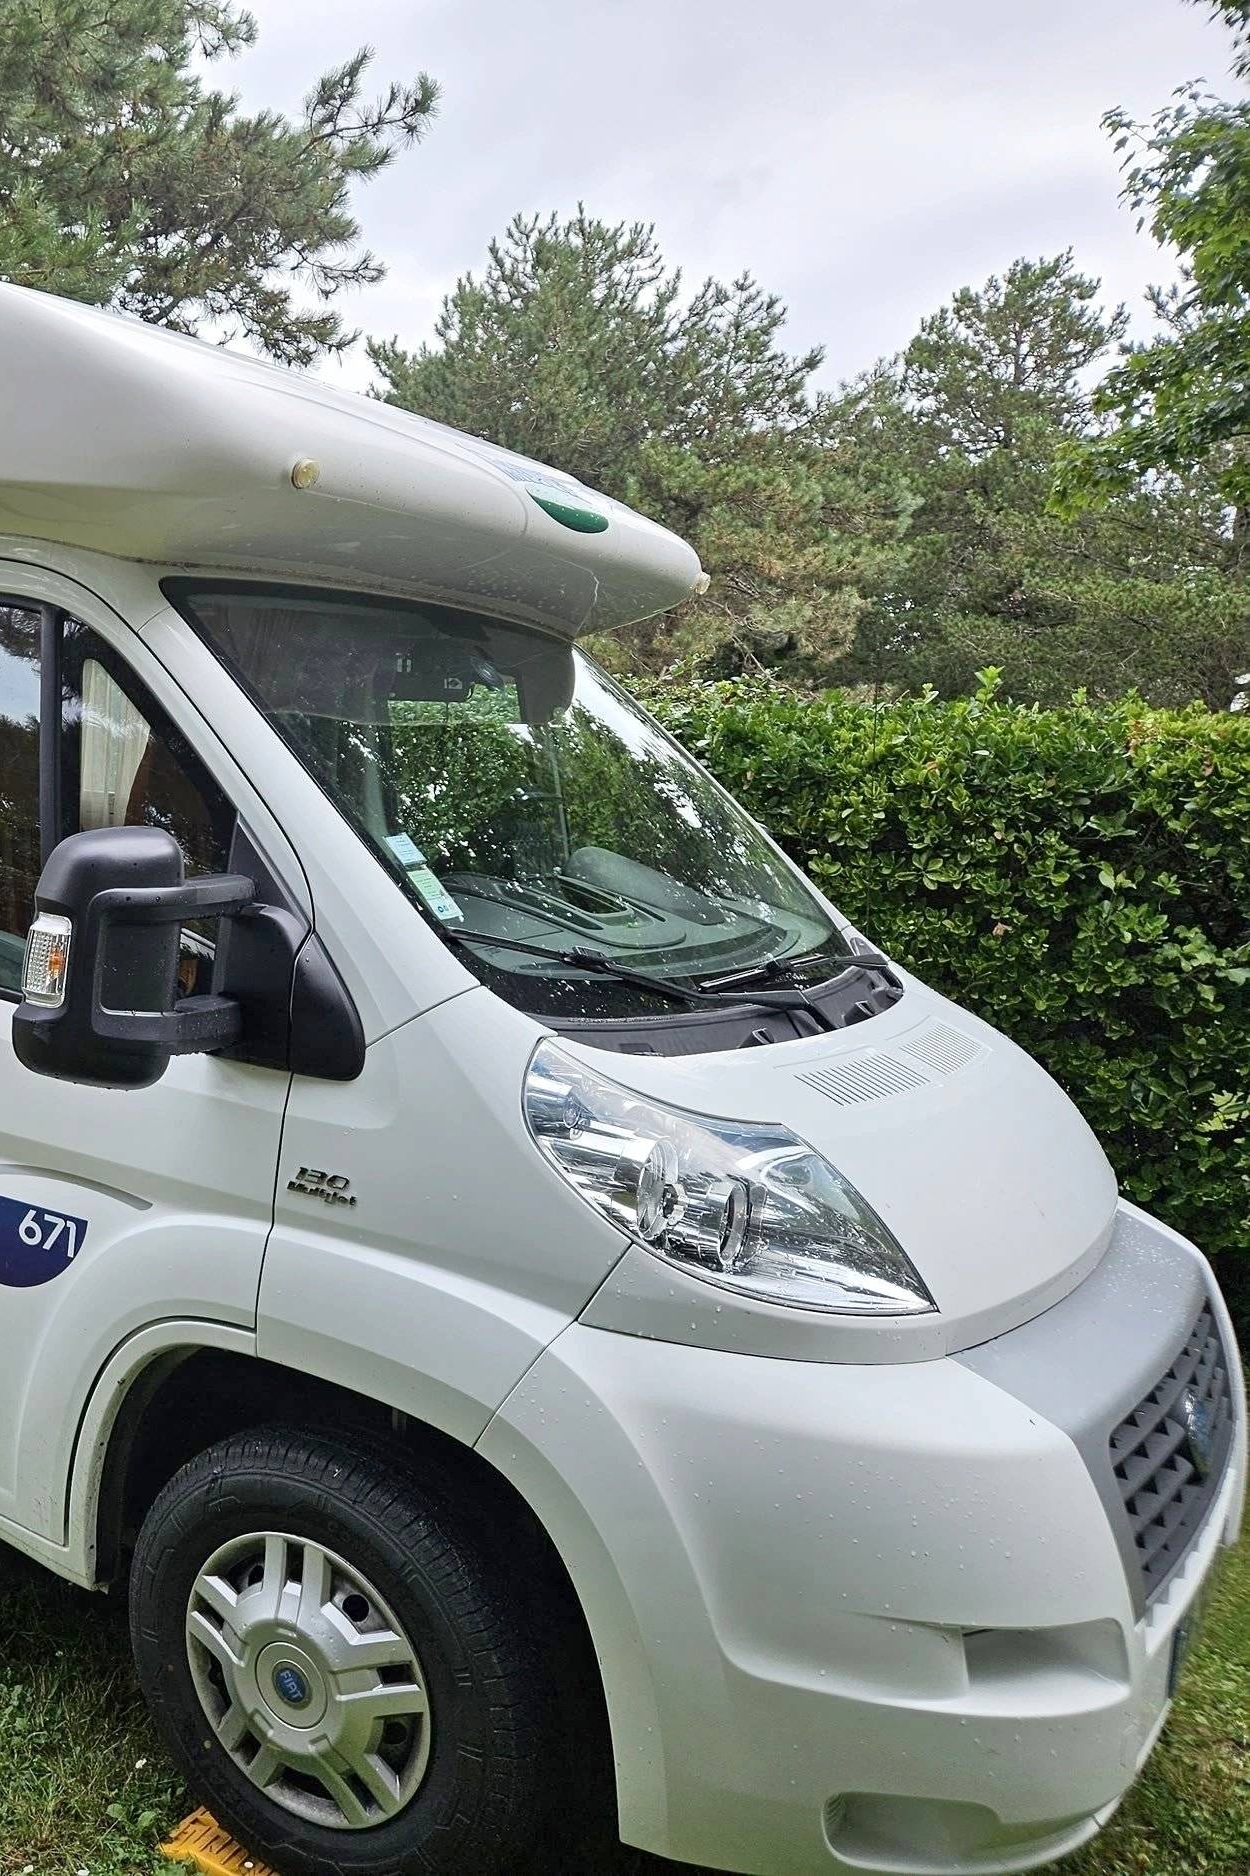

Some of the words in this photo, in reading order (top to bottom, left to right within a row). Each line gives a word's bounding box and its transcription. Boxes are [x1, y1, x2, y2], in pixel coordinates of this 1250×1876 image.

[296, 1166, 350, 1190] 130
[18, 1209, 77, 1258] 671
[280, 1670, 303, 1699] FIAT
